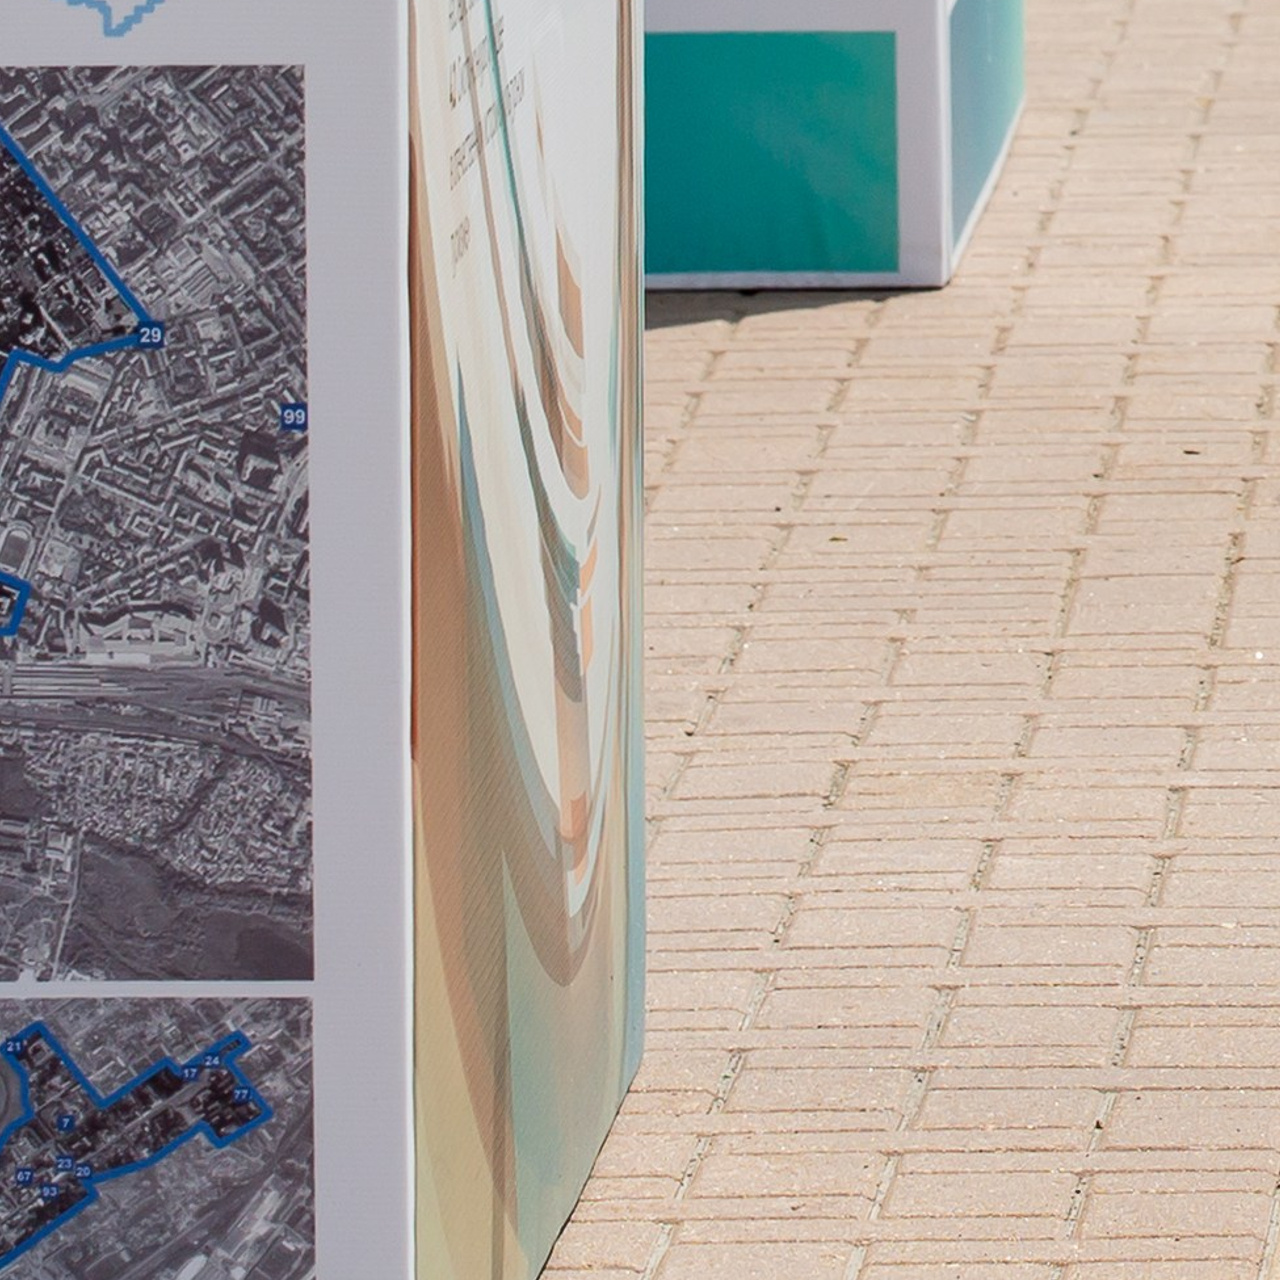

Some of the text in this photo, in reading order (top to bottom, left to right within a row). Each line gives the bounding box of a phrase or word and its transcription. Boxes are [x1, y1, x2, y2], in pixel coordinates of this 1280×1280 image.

[140, 327, 162, 343] 29
[283, 409, 306, 424] 99
[6, 1041, 21, 1052] 21
[204, 1056, 220, 1066] 24
[183, 1068, 197, 1078] 17
[62, 1117, 70, 1128] 7
[56, 1158, 73, 1170] 23
[16, 1171, 31, 1181] 67
[76, 1166, 90, 1177] 20
[42, 1186, 57, 1197] 93
